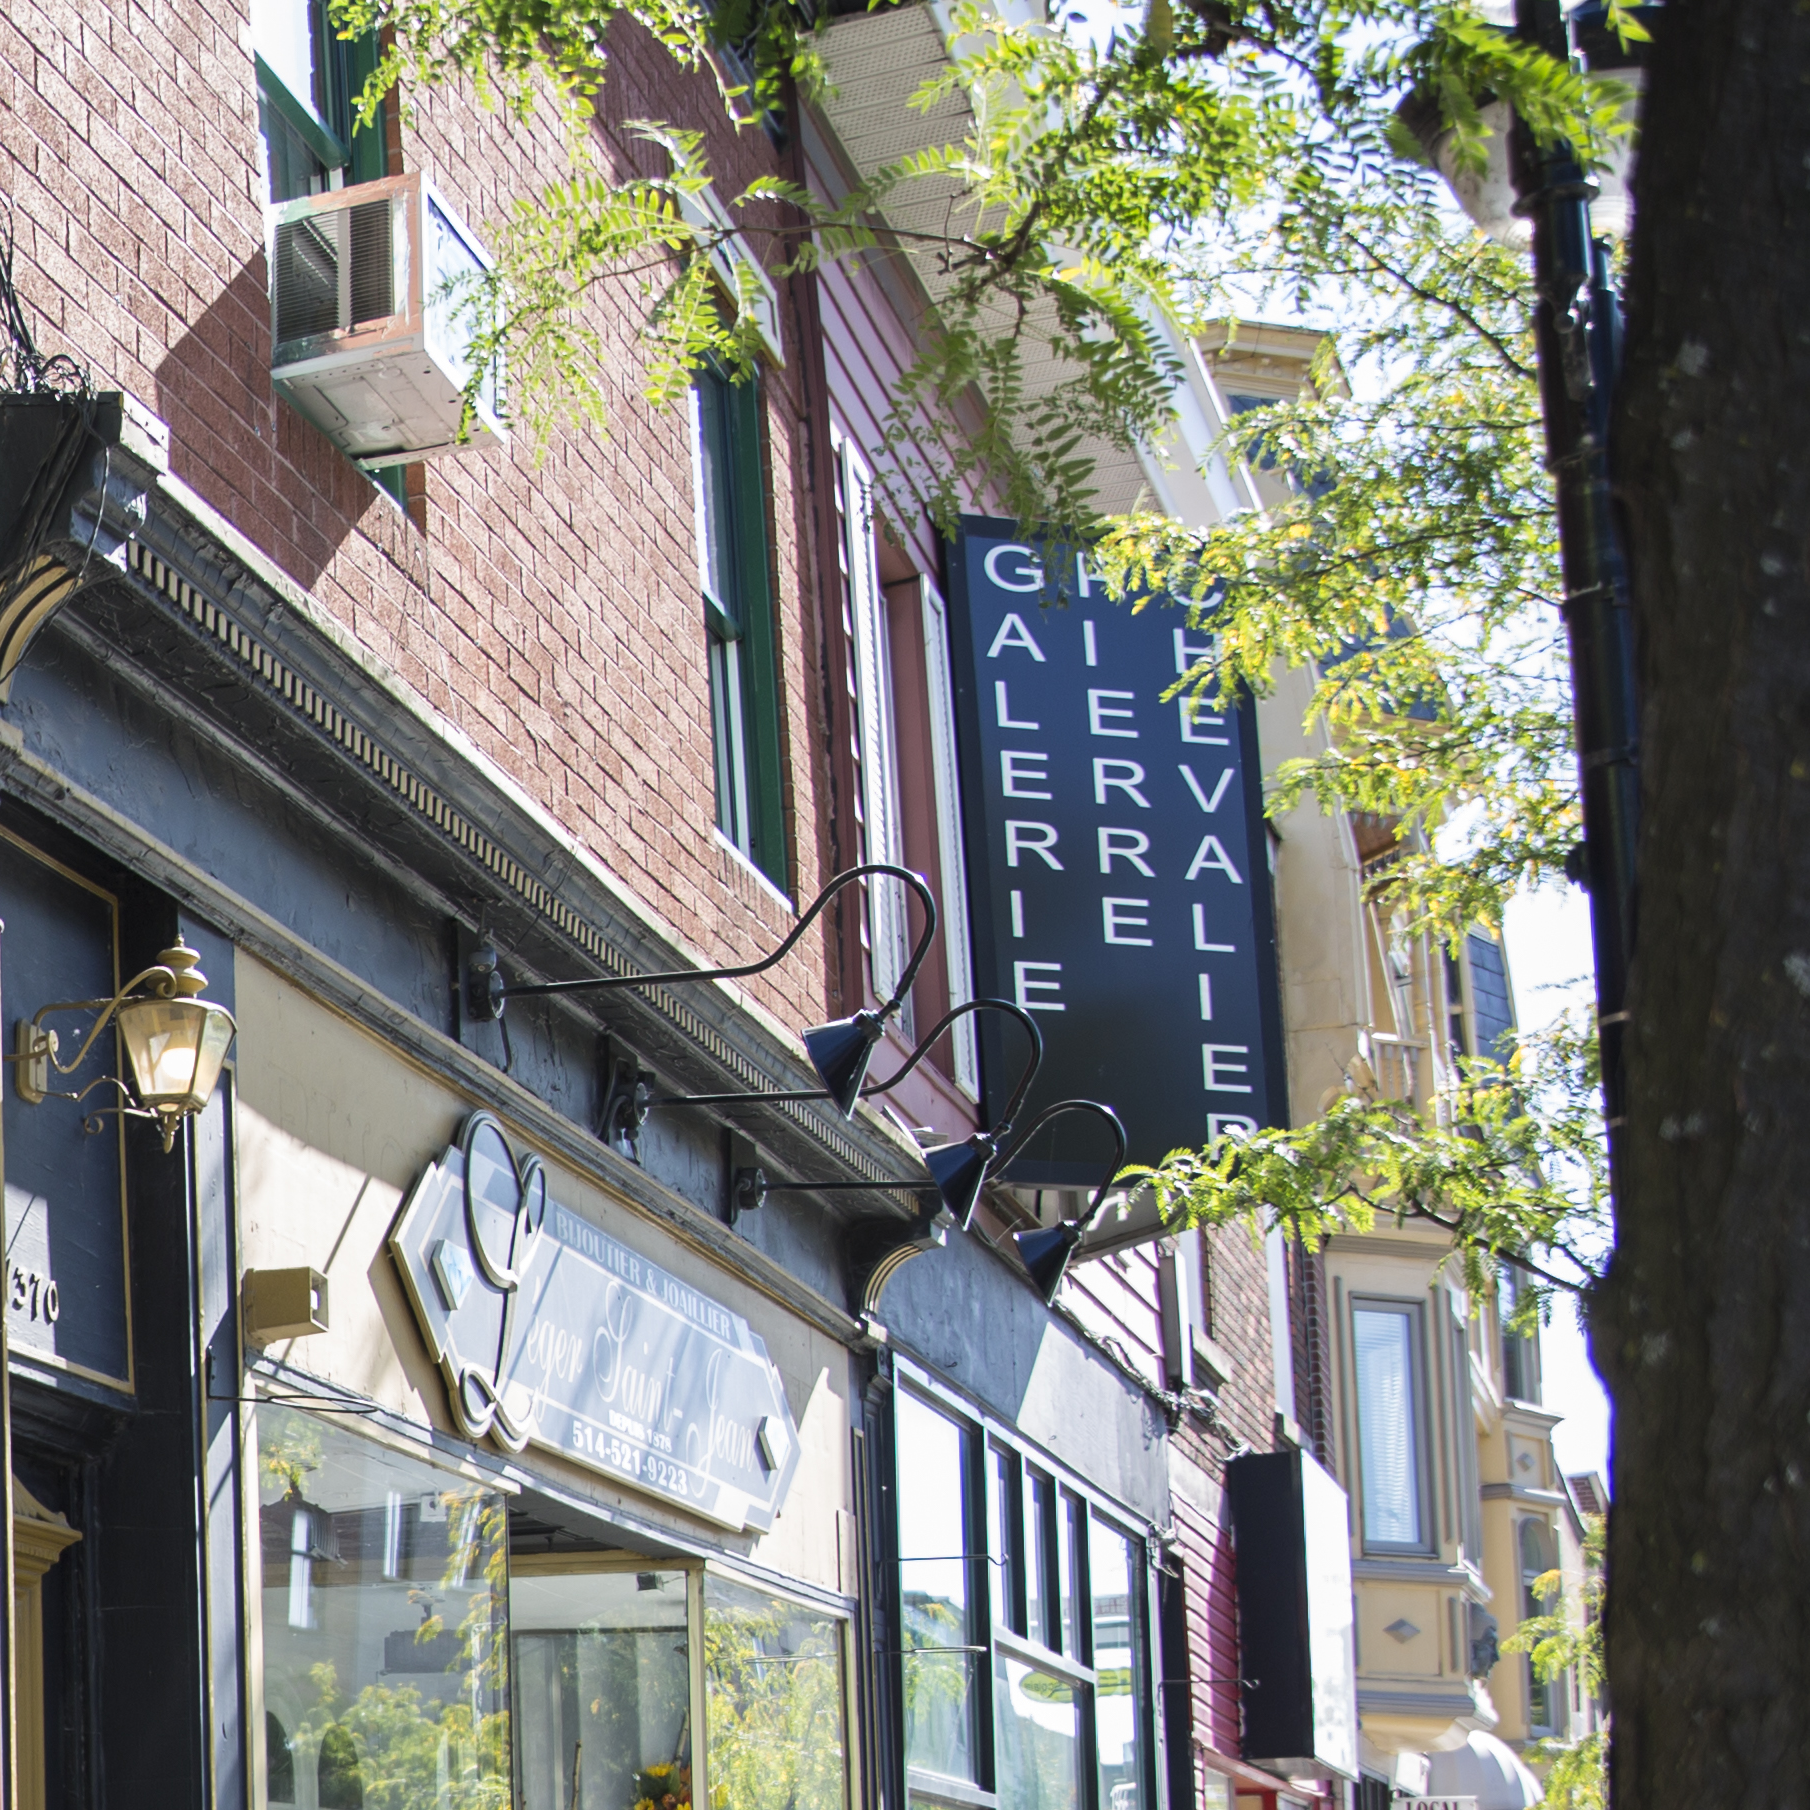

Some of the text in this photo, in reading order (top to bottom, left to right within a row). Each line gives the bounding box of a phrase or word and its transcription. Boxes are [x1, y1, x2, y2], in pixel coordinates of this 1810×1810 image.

[983, 545, 1066, 1012] GALERIE
[556, 1210, 732, 1341] BIJOUTIER & JOAILLIER
[571, 1420, 689, 1496] 514-521-9223
